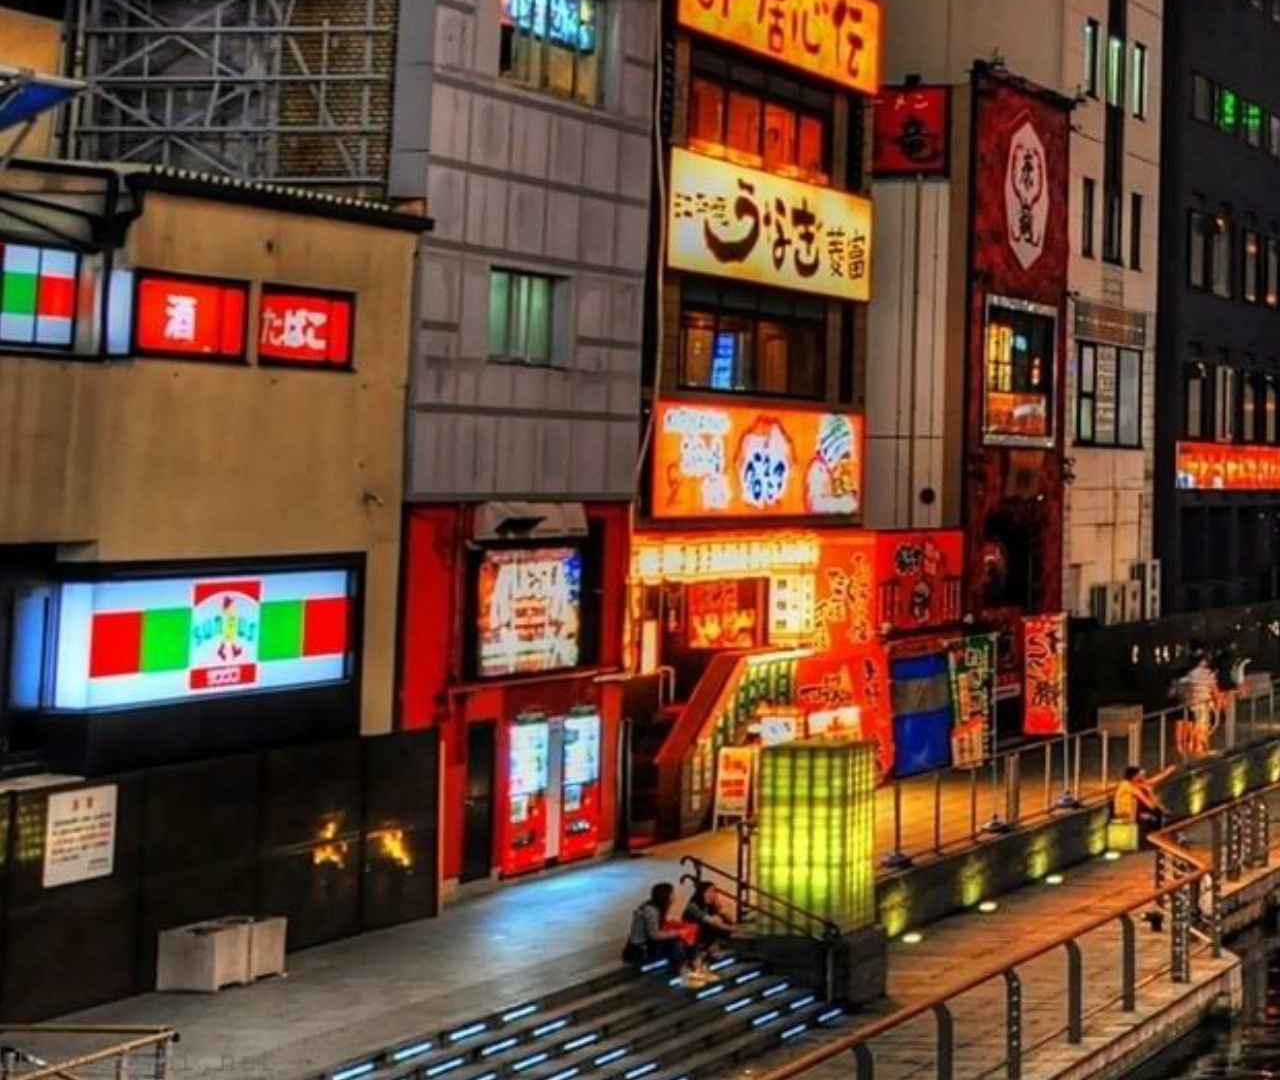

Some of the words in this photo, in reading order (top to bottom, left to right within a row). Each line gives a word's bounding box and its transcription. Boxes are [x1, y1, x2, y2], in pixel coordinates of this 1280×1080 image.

[164, 294, 198, 342] 酒
[261, 306, 328, 351] たばこ
